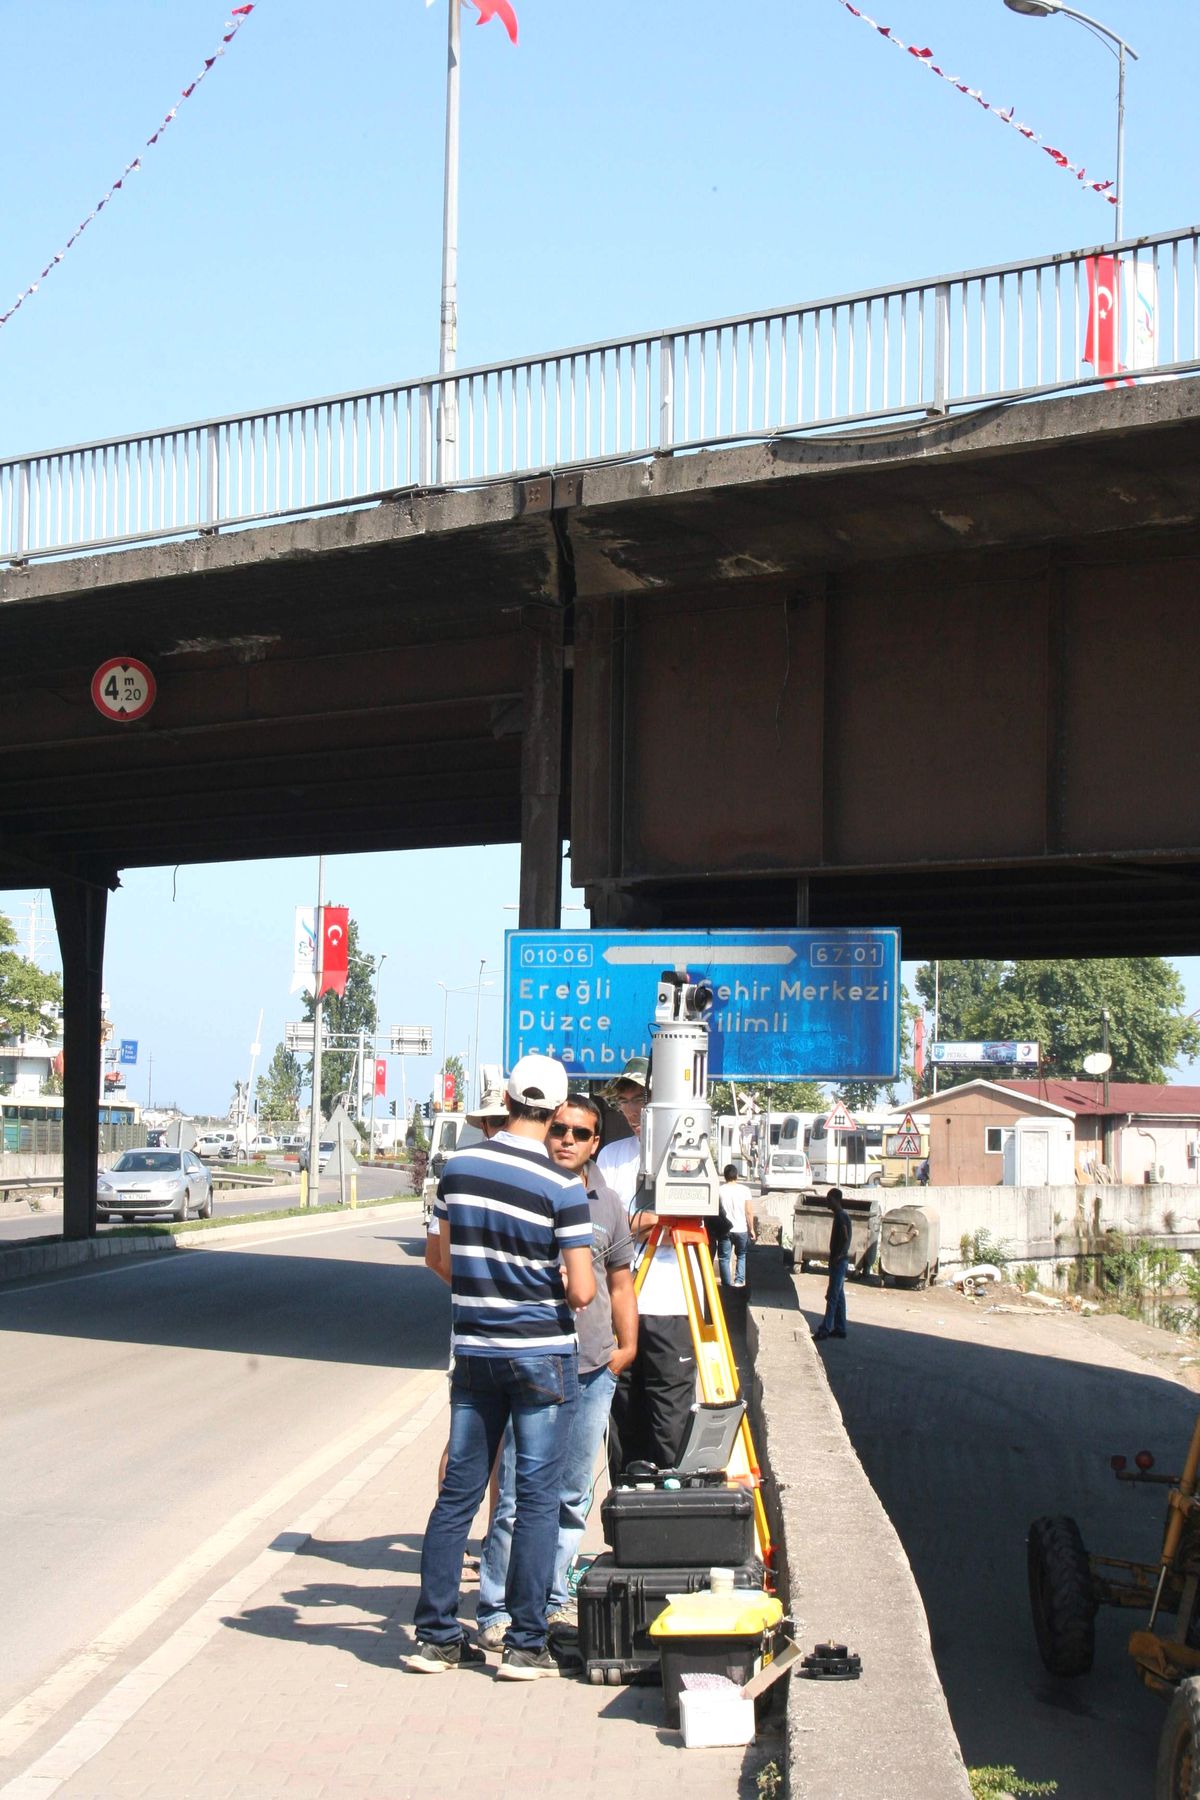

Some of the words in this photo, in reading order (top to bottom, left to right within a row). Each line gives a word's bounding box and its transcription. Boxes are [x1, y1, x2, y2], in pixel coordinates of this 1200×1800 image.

[523, 948, 589, 964] 010-06
[816, 947, 878, 963] 67-01
[519, 977, 611, 1005] Ereğli
[779, 979, 889, 1002] Merkezi
[519, 1010, 612, 1032] Düzce
